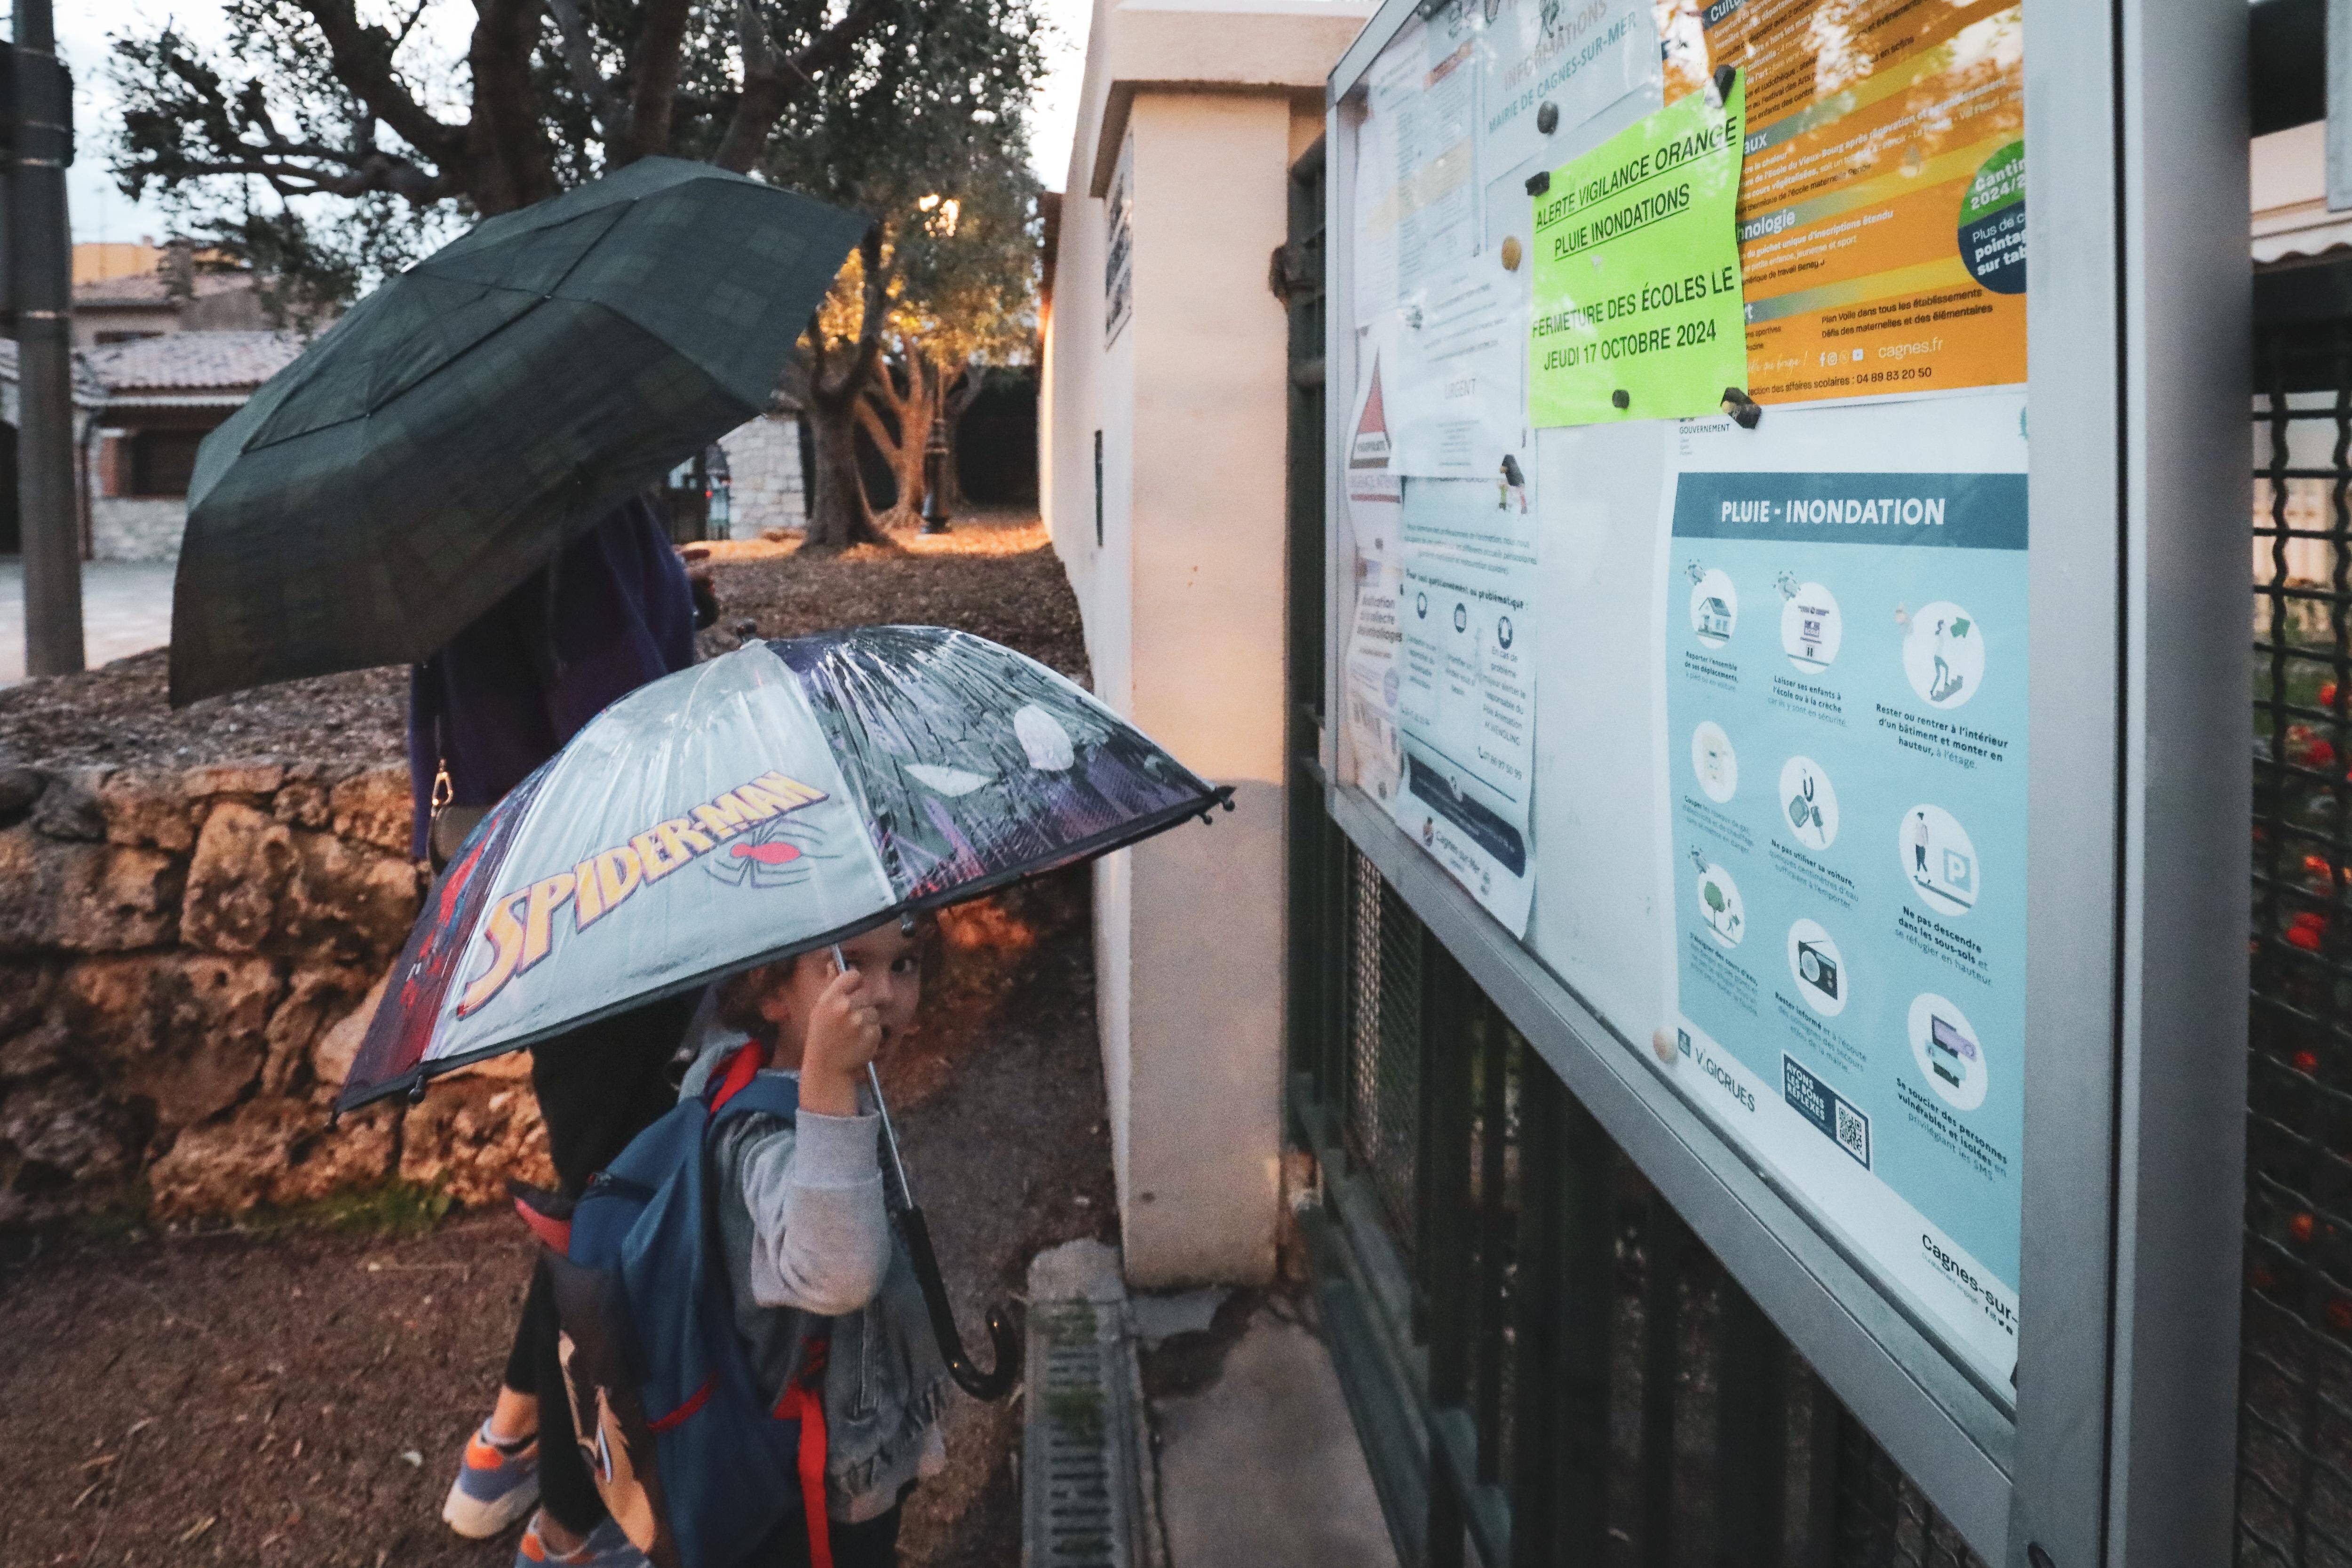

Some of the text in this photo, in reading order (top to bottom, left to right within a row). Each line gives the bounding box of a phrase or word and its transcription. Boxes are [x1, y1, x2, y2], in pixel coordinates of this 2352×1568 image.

[1504, 1, 1607, 91] INFORMATIONS
[1489, 99, 1518, 133] MAIRIE
[1521, 88, 1534, 110] DE
[1537, 11, 1636, 98] CAGNES-SUR-MER
[1744, 133, 1767, 154] aux
[1537, 116, 1737, 227] ALERTE VIGILANCE ORANGE
[1555, 183, 1690, 256] PLUIE INONDATIONS
[1738, 209, 1796, 241] nologie
[1756, 241, 1781, 257] guichet
[1782, 236, 1807, 249] unique
[1862, 210, 1893, 226] étendu
[1972, 225, 1997, 243] Plus
[1999, 216, 2015, 231] de
[1837, 235, 1857, 247] sport
[1769, 265, 1796, 279] de travail
[1977, 258, 2000, 276] sur
[1533, 265, 1734, 338] FERMETURE DES ÉCOLES LE
[1822, 288, 1983, 324] Plan Voile dans tous les établissements
[1822, 303, 1994, 338] Défis des maternelles et des élémentaires
[1544, 318, 1716, 371] JEUDI 17 OCTOBRE 2024
[1878, 336, 1943, 360] cagnes.fr
[1748, 366, 1932, 396] rection des affaires scolaires 04 89 83 20 50
[1680, 424, 1730, 434] GOUVERNEMENT
[1722, 498, 1945, 525] PLUIE INONDATION
[1686, 651, 1737, 671] Reporter l'ensemble
[1773, 686, 1793, 699] l'école
[1811, 697, 1816, 705] la
[1819, 701, 1842, 713] crèche
[1774, 676, 1796, 687] Laisser
[1810, 686, 1835, 699] enfants
[1837, 692, 1841, 700] à
[1876, 703, 2008, 748] Rester ou rentrer à l'intérieur
[1879, 718, 2002, 762] d'un bâtiment et monter en
[1899, 736, 1934, 756] hauteur,
[1937, 748, 1941, 757] à
[1772, 839, 1780, 849] Ne
[1782, 846, 1792, 855] pas
[1794, 852, 1816, 867] utiliser
[1828, 869, 1854, 889] voiture,
[458, 771, 830, 1020] SPIDER-MAN
[1899, 917, 1918, 933] dans
[1920, 927, 1932, 941] les
[1935, 937, 1975, 964] sous-sols
[1903, 906, 1981, 954] Ne pas descendre
[1907, 934, 1939, 956] réfugier
[1941, 954, 1952, 964] en
[1696, 1047, 1755, 1112] VGICRUES
[1787, 1063, 1813, 1090] AYONS
[1788, 1073, 1824, 1109] LES BONS
[1897, 1077, 2007, 1164] Se soucier des personnes
[1898, 1092, 1946, 1132] vulnérables
[1949, 1130, 1958, 1141] et
[1961, 1136, 1992, 1166] isolées
